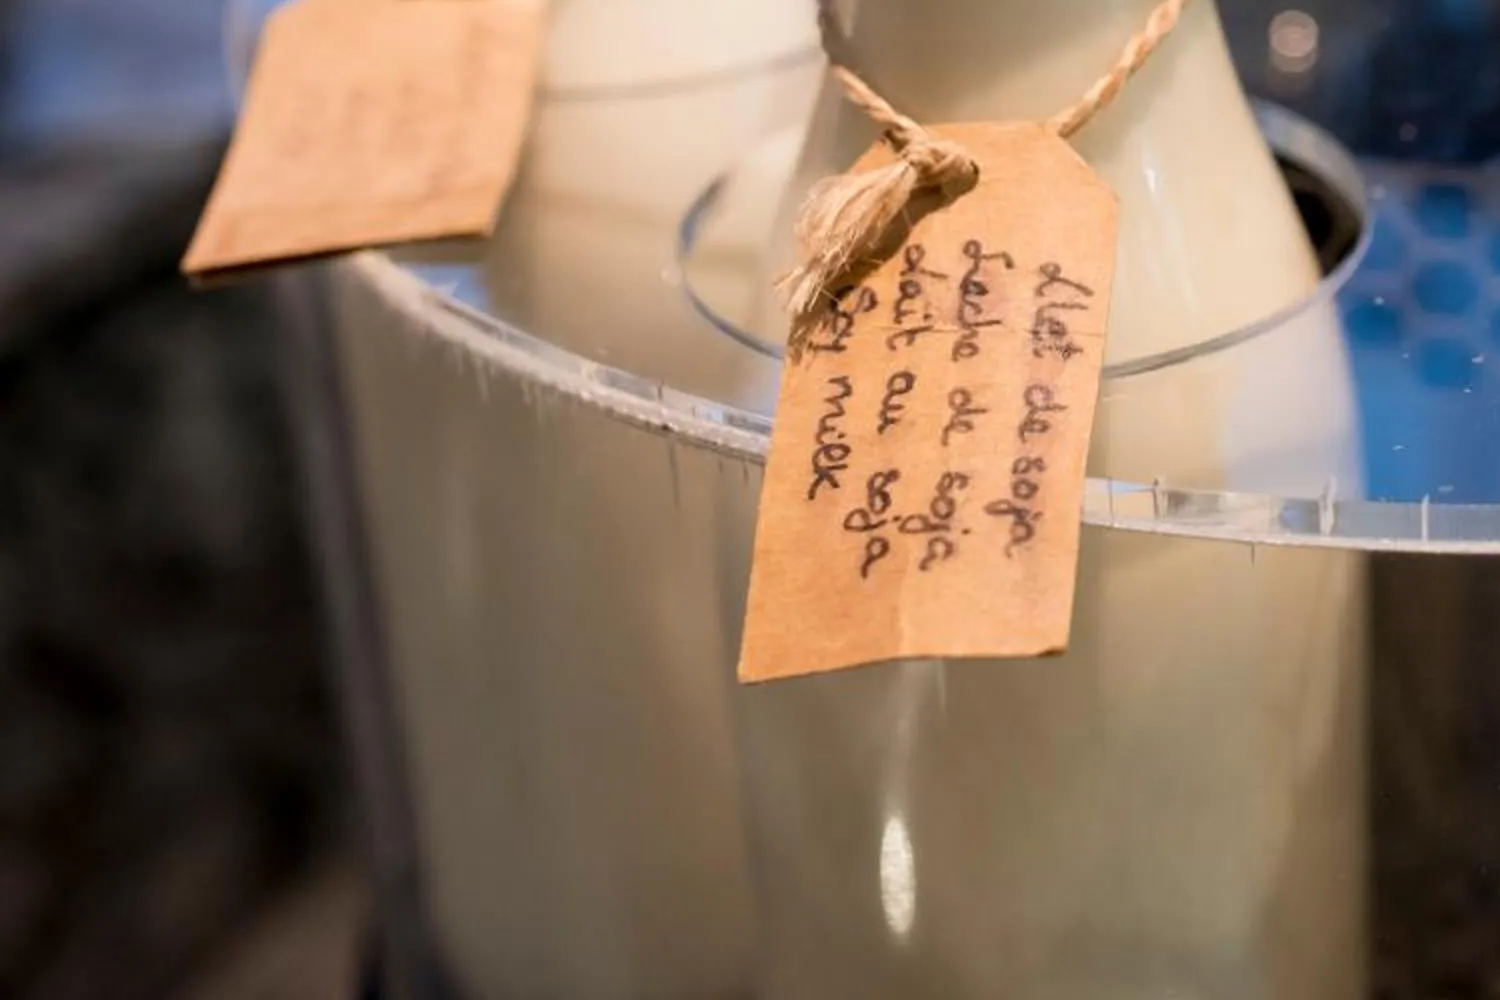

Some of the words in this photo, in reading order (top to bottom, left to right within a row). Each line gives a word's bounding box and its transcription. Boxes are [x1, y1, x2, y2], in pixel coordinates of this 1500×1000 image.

[886, 244, 946, 352] Lait
[952, 239, 1014, 361] Leche
[877, 370, 916, 434] au
[941, 388, 986, 447] de
[1019, 385, 1067, 445] de
[844, 469, 898, 578] soja
[901, 471, 970, 570] soja
[985, 455, 1046, 557] soja
